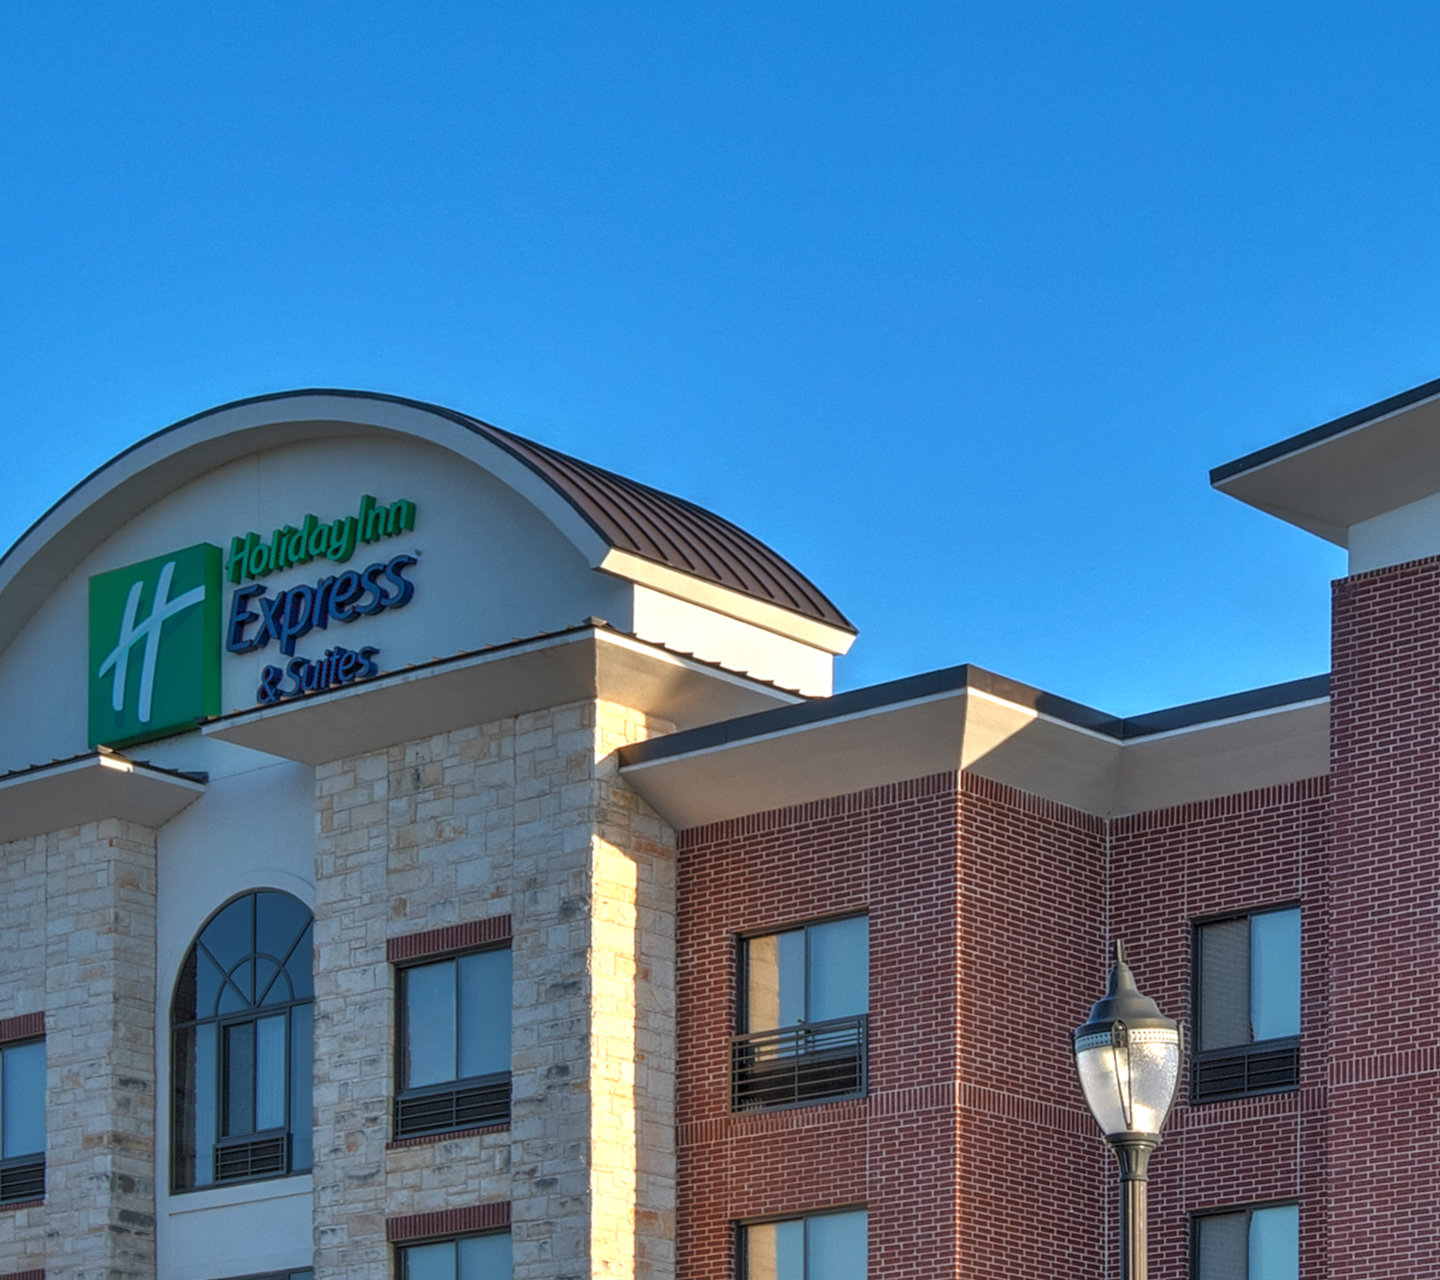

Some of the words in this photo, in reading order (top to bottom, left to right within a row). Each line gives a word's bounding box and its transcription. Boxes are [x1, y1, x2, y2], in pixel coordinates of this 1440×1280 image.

[226, 514, 359, 584] Holiday
[357, 494, 416, 544] Inn
[226, 555, 418, 656] Express
[257, 665, 284, 703] &
[285, 646, 380, 697] Suites
